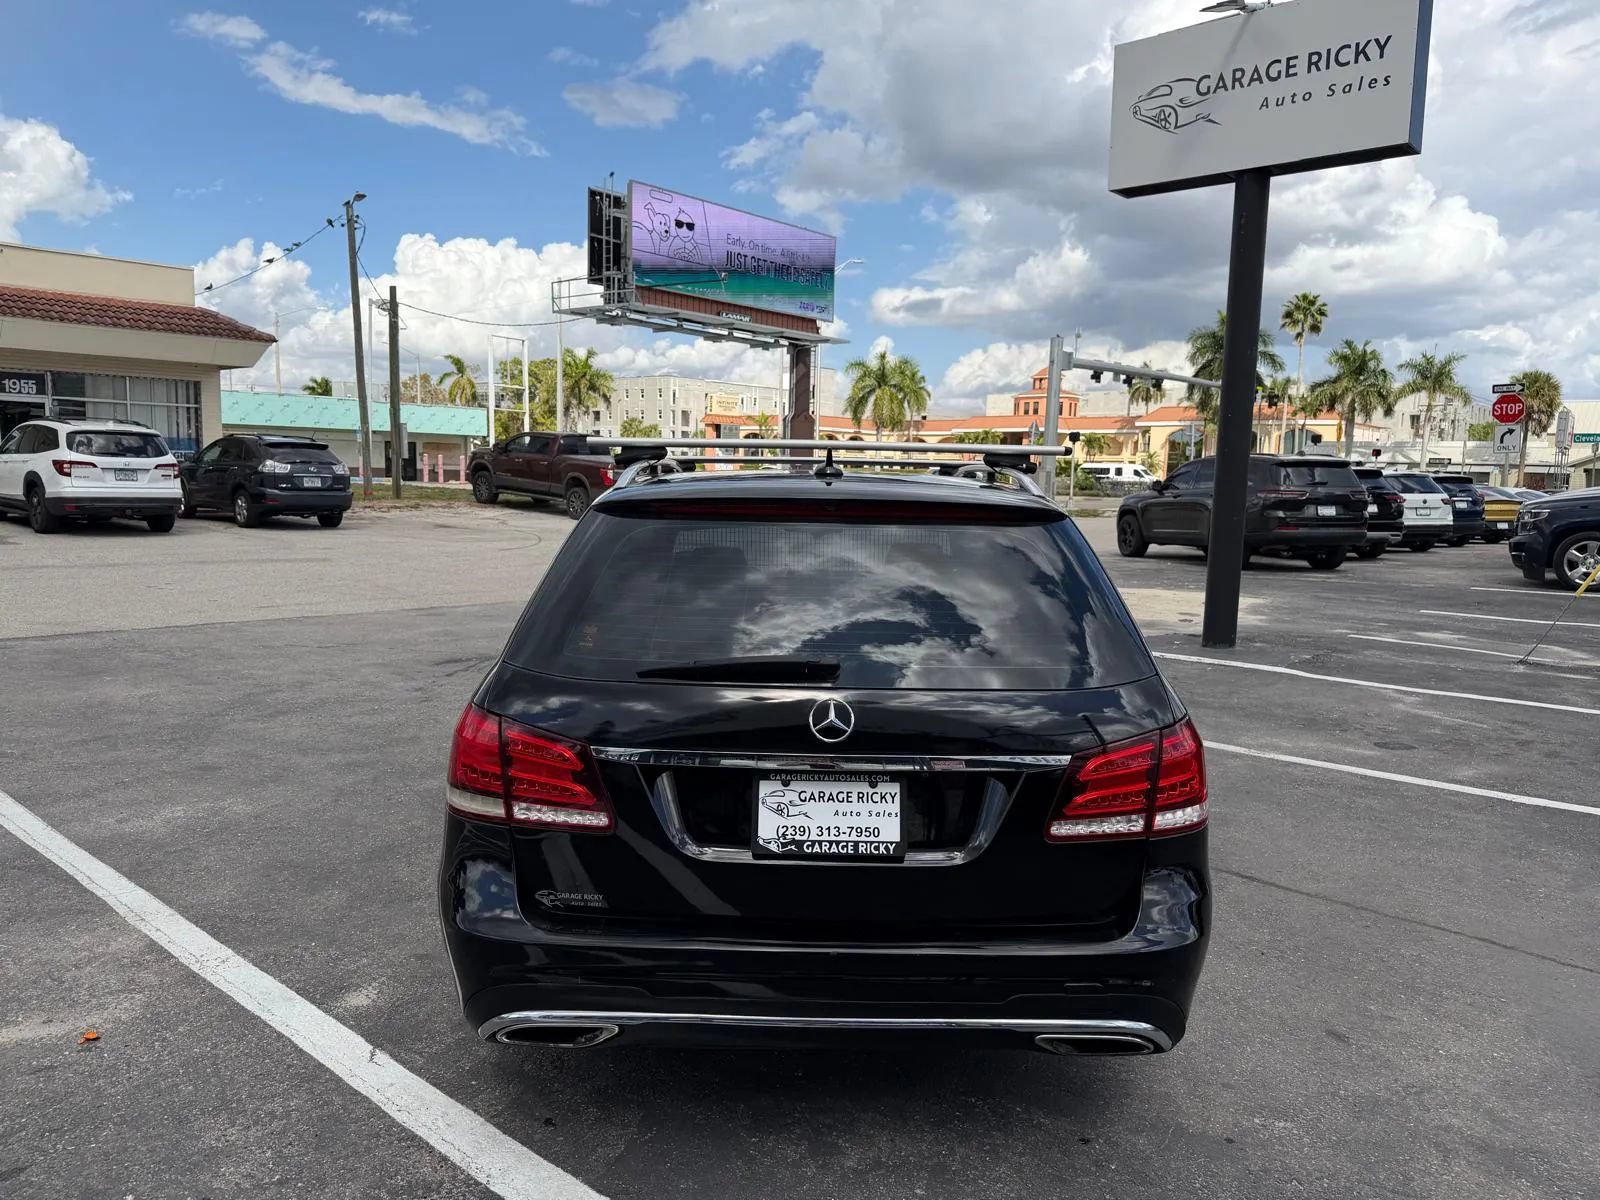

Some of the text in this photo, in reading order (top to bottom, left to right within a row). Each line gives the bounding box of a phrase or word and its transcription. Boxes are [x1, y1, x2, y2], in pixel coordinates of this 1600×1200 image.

[1195, 34, 1393, 97] GARAGE RICKY
[1258, 73, 1393, 110] Auto Sales
[725, 250, 748, 270] JUST
[750, 255, 768, 276] GET
[1, 378, 37, 395] 1955
[1493, 403, 1523, 415] STOP
[1496, 444, 1517, 452] ONLY
[770, 773, 890, 782] GARAGERICKYAUTOSALES.COM
[798, 790, 898, 804] GARAGE RICKY
[833, 809, 899, 818] Auto Sales
[776, 825, 881, 839] (239) 313-7950
[803, 842, 897, 854] GARAGE RICKY
[556, 892, 583, 900] GARAGE
